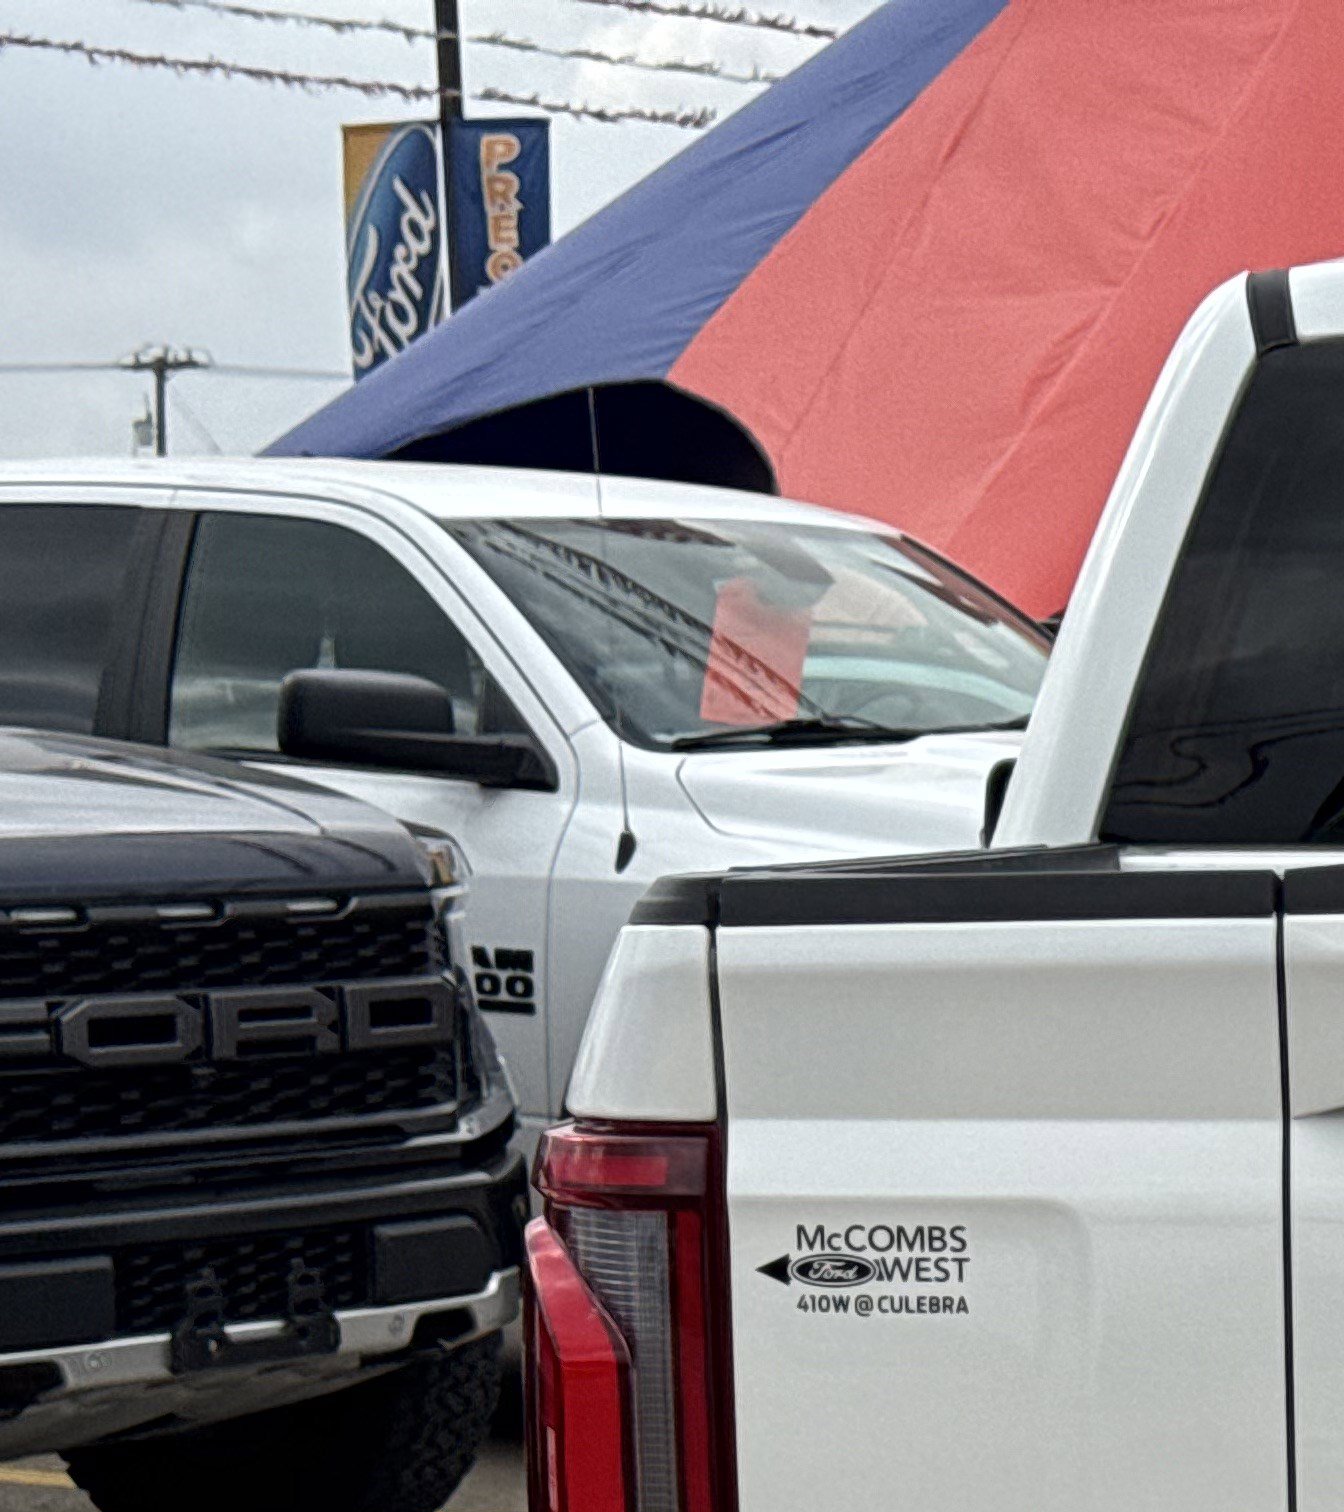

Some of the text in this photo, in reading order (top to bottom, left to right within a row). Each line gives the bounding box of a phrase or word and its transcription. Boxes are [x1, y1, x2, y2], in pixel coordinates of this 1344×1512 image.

[353, 174, 435, 368] Ford
[796, 1224, 968, 1252] McCOMBS
[807, 1256, 971, 1283] Ford WEST
